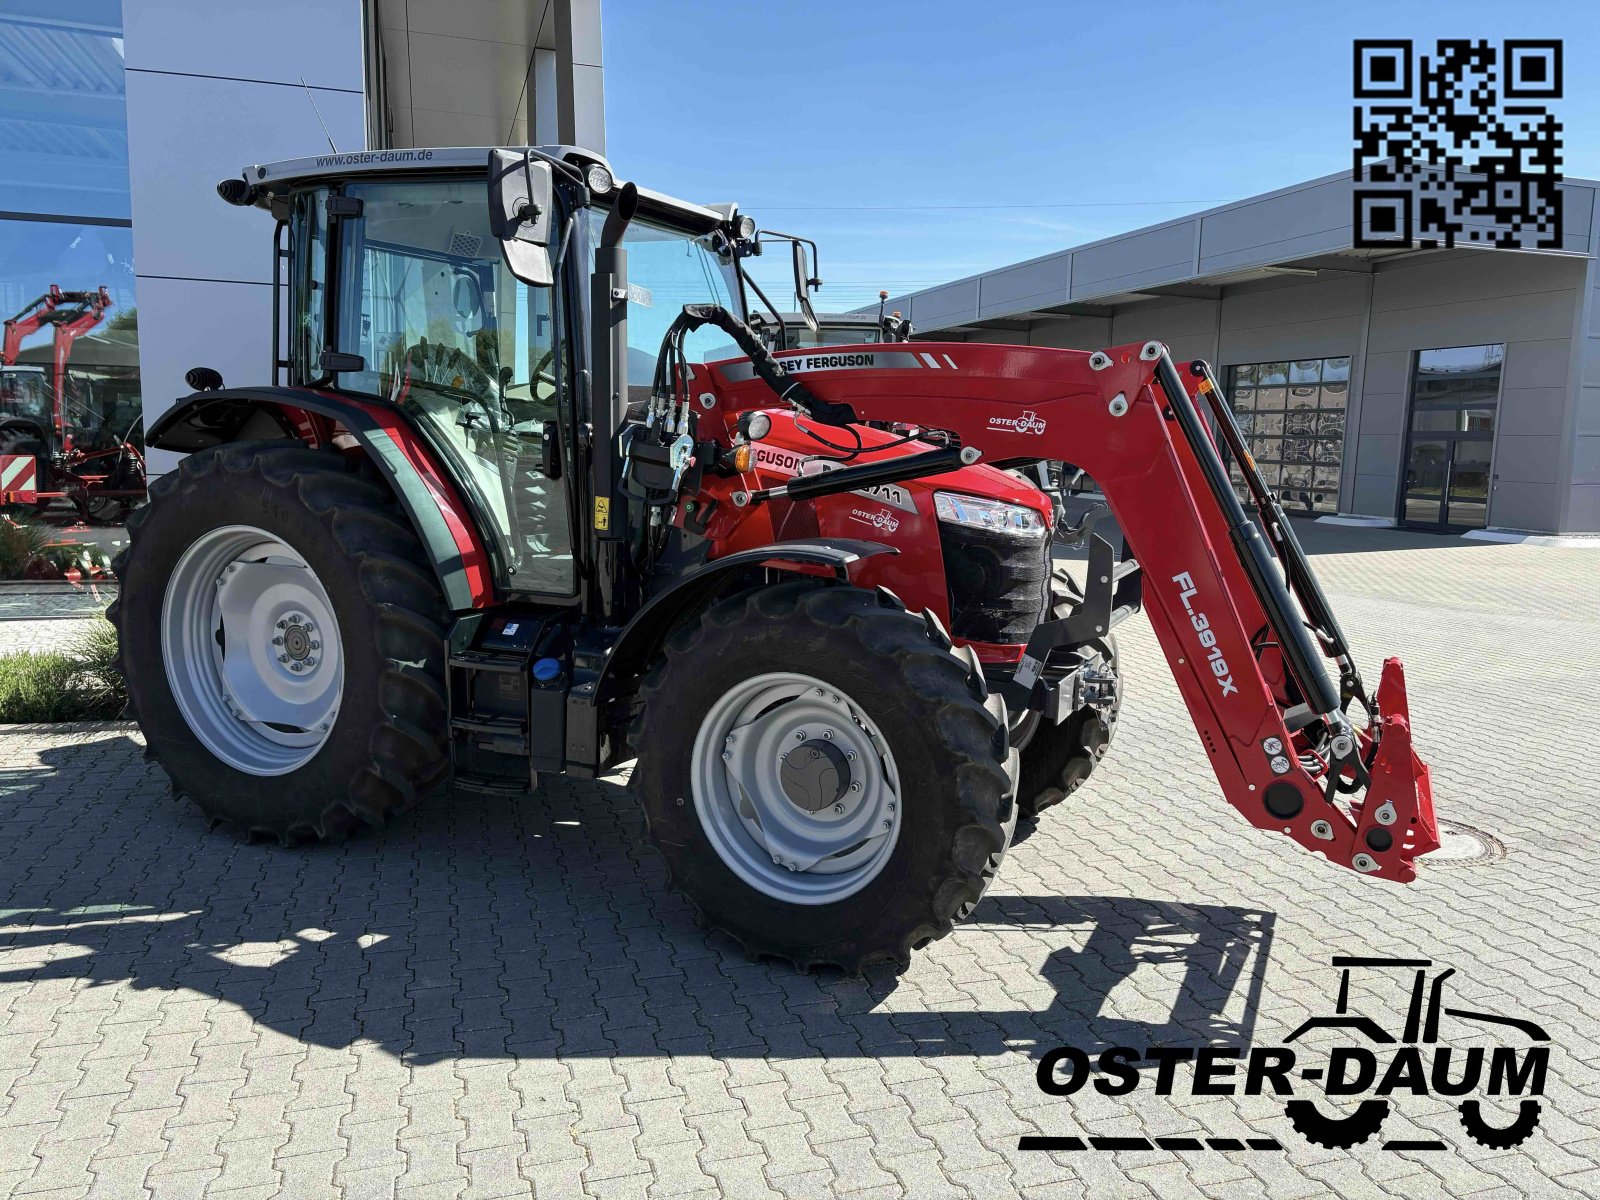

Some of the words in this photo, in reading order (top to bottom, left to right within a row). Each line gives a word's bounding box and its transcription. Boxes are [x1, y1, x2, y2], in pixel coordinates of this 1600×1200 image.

[316, 149, 433, 167] www.oster-daum.de
[806, 354, 875, 369] FERGUSON
[989, 417, 1046, 429] OSTER-DAUM
[756, 449, 804, 470] GUSON
[852, 509, 899, 529] OSTER-DAUM
[1171, 571, 1239, 698] FL.3919X
